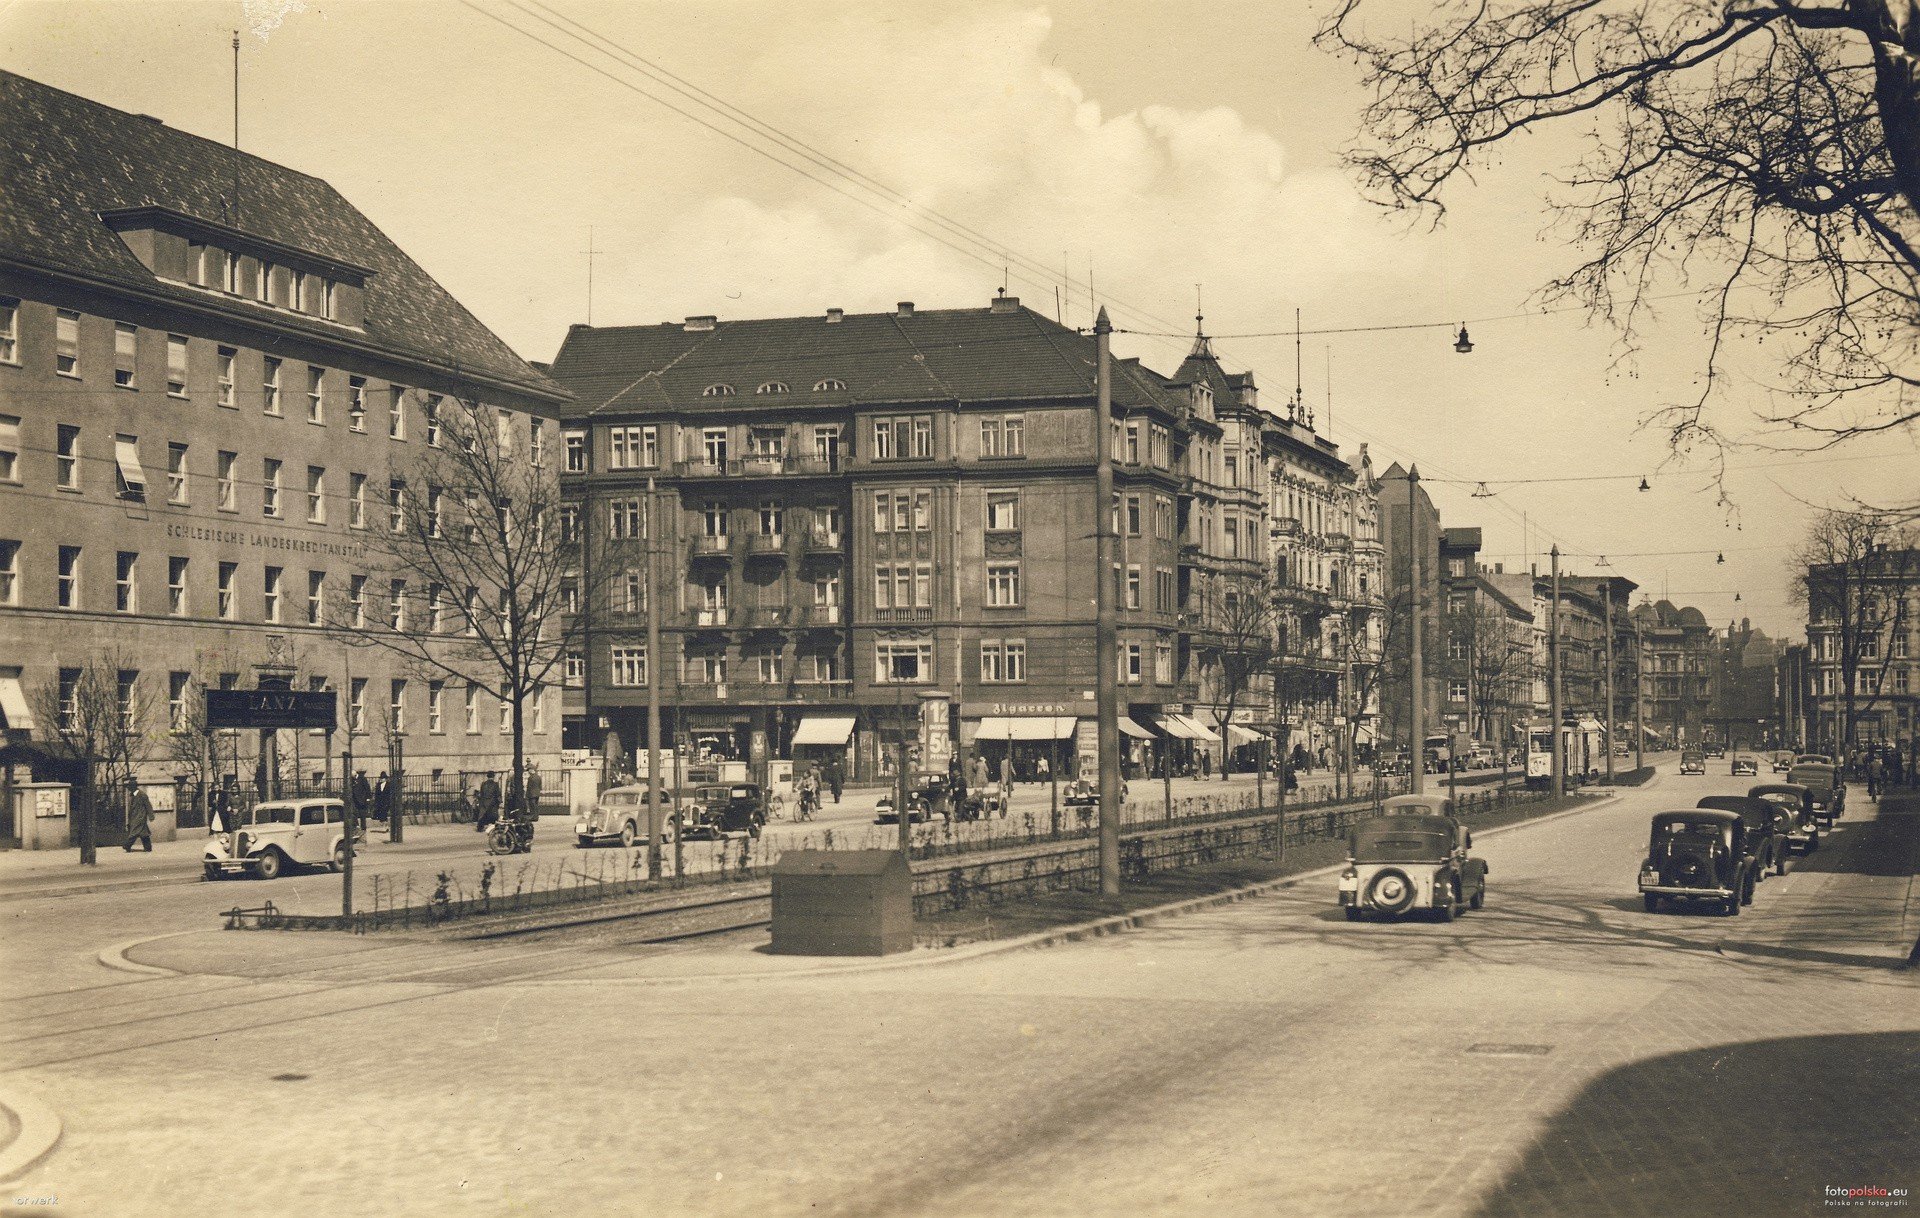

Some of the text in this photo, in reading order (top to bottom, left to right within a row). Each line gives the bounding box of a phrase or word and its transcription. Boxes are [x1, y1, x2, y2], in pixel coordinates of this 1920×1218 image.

[167, 525, 368, 559] SCHLESISCHE LANDESKREDITANSTALT
[249, 695, 296, 710] LANZ
[929, 701, 950, 723] 12
[929, 732, 950, 754] 50
